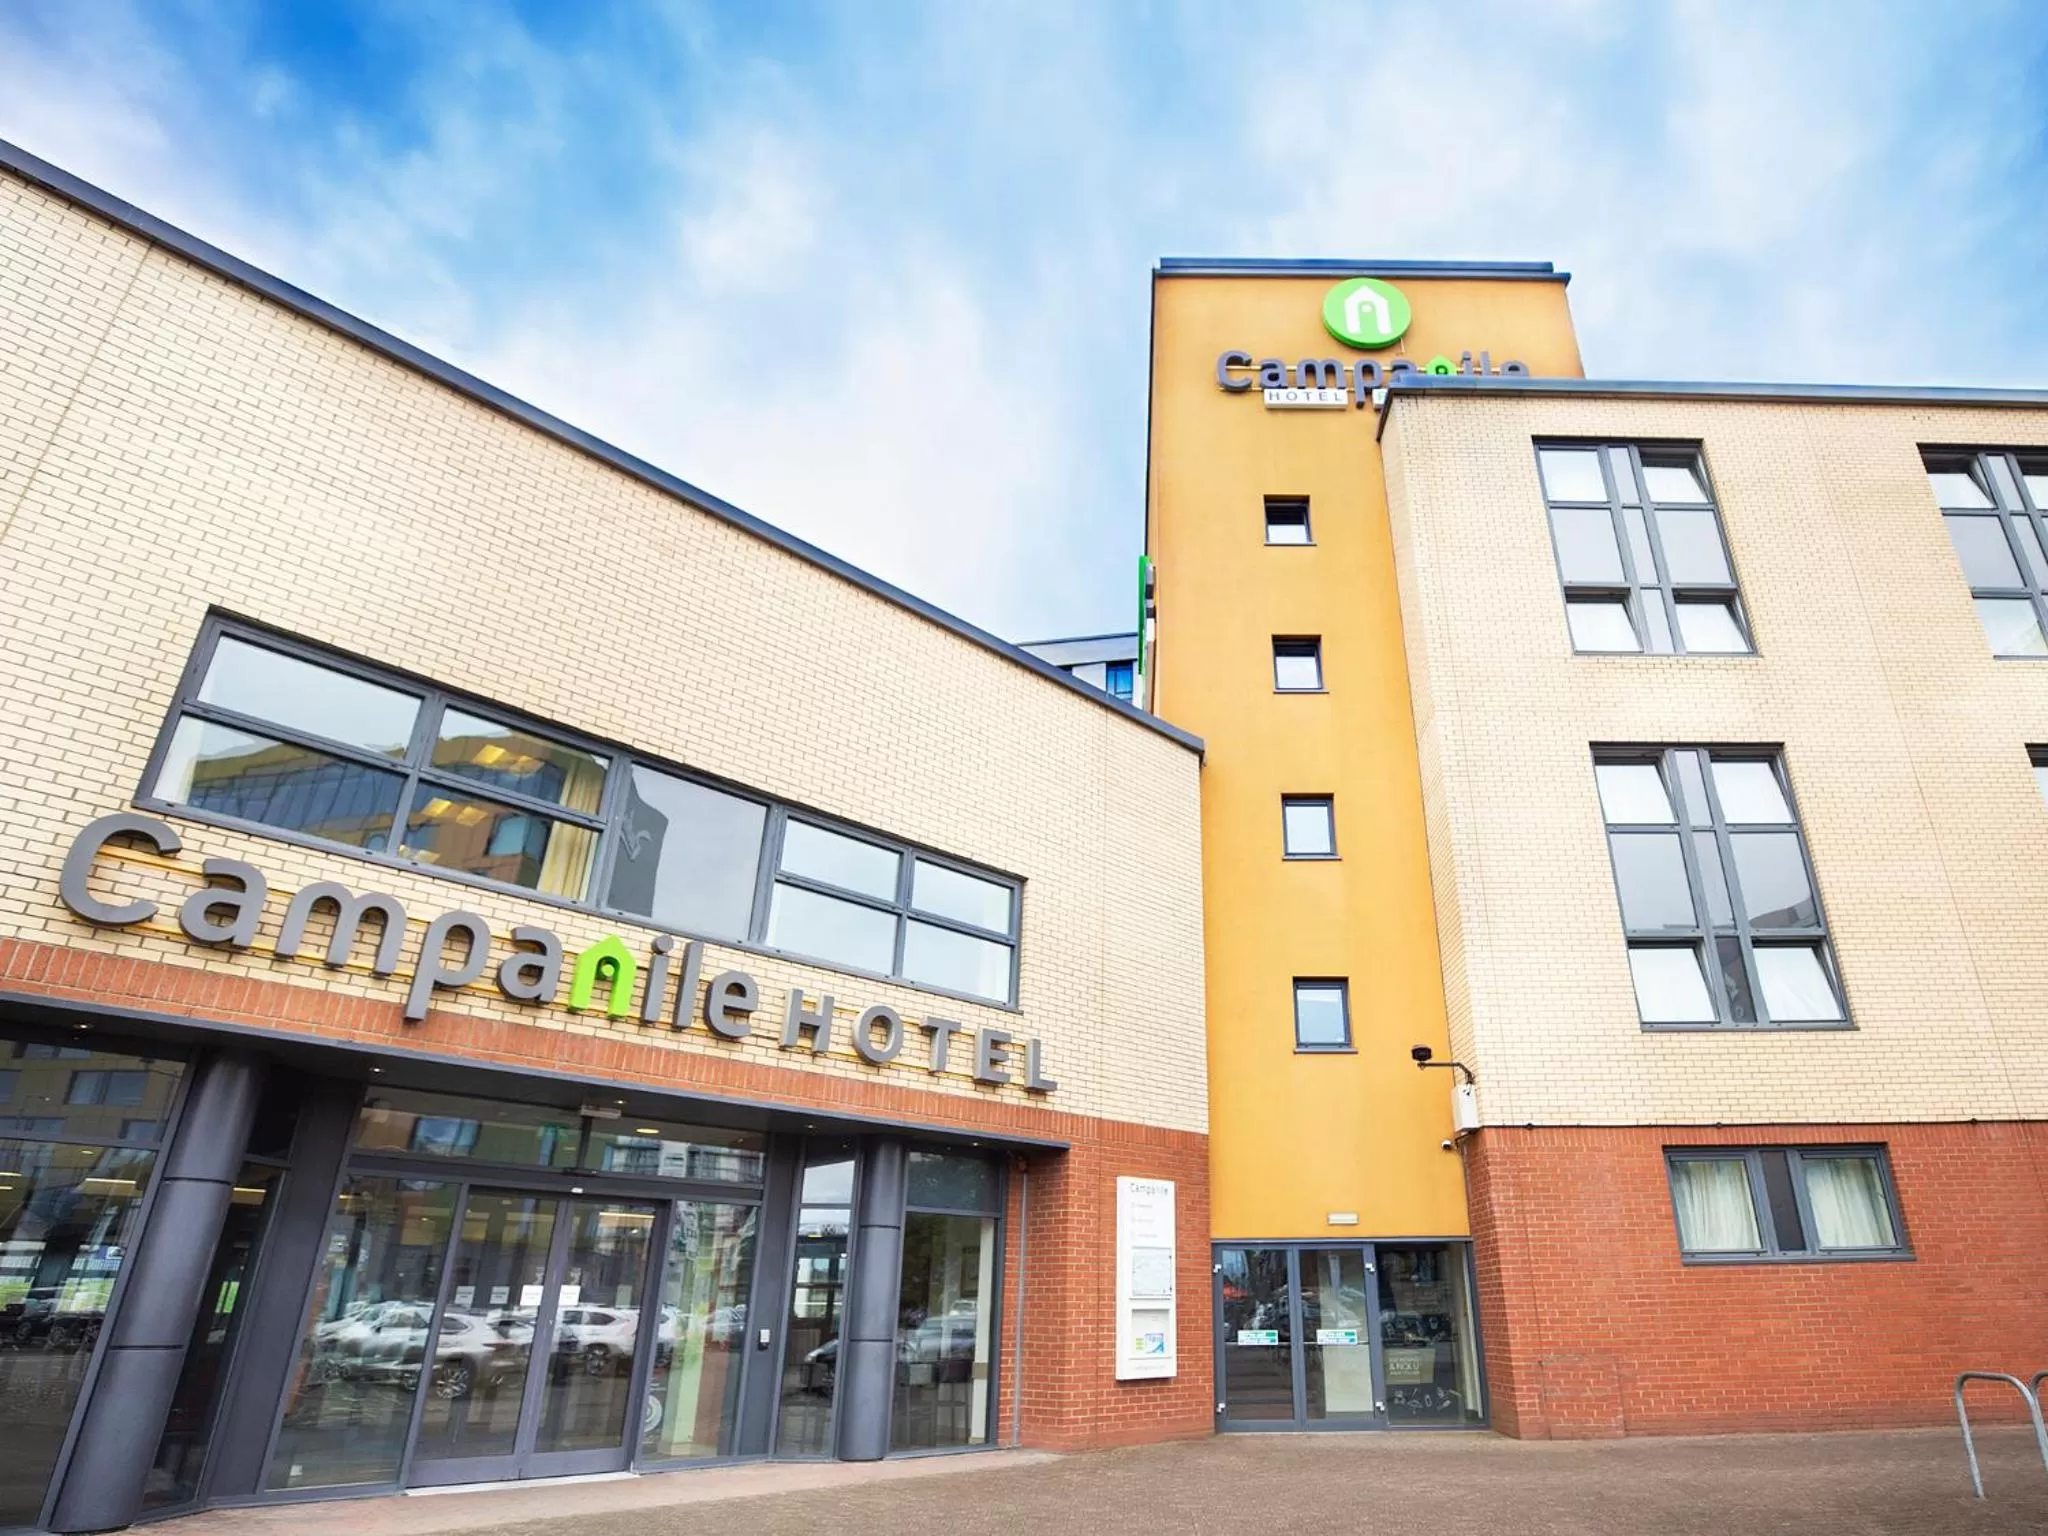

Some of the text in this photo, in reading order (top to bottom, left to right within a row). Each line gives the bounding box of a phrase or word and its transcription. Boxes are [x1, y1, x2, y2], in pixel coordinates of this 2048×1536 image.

[1268, 390, 1344, 401] HOTEL
[59, 812, 1058, 1093] Campanile HOTEL
